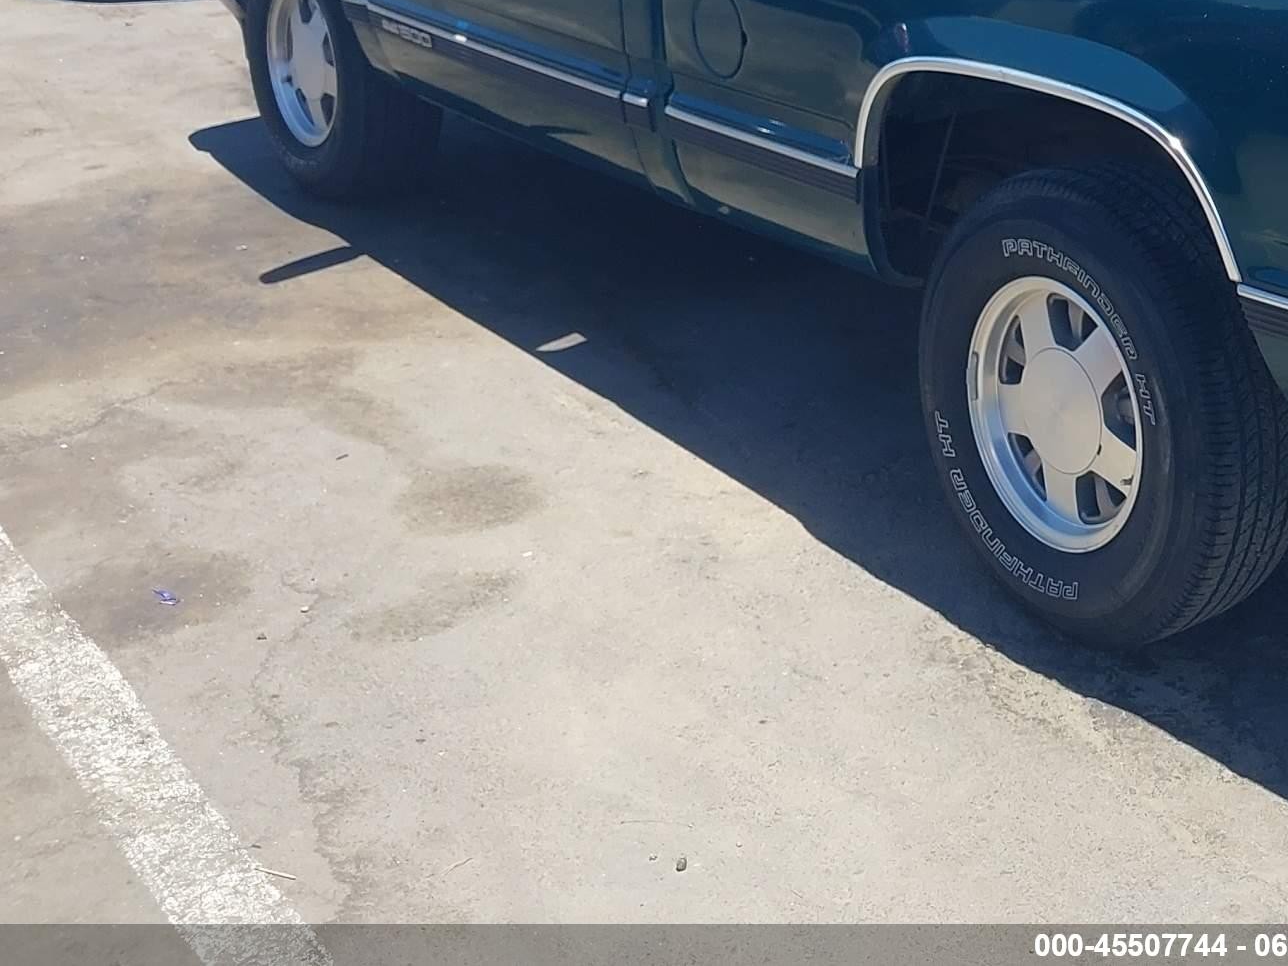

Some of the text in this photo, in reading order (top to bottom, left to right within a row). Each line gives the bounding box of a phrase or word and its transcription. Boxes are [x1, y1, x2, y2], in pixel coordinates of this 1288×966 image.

[1001, 238, 1156, 426] PATHFINDER HT
[934, 410, 1079, 600] PATHFINDER HT
